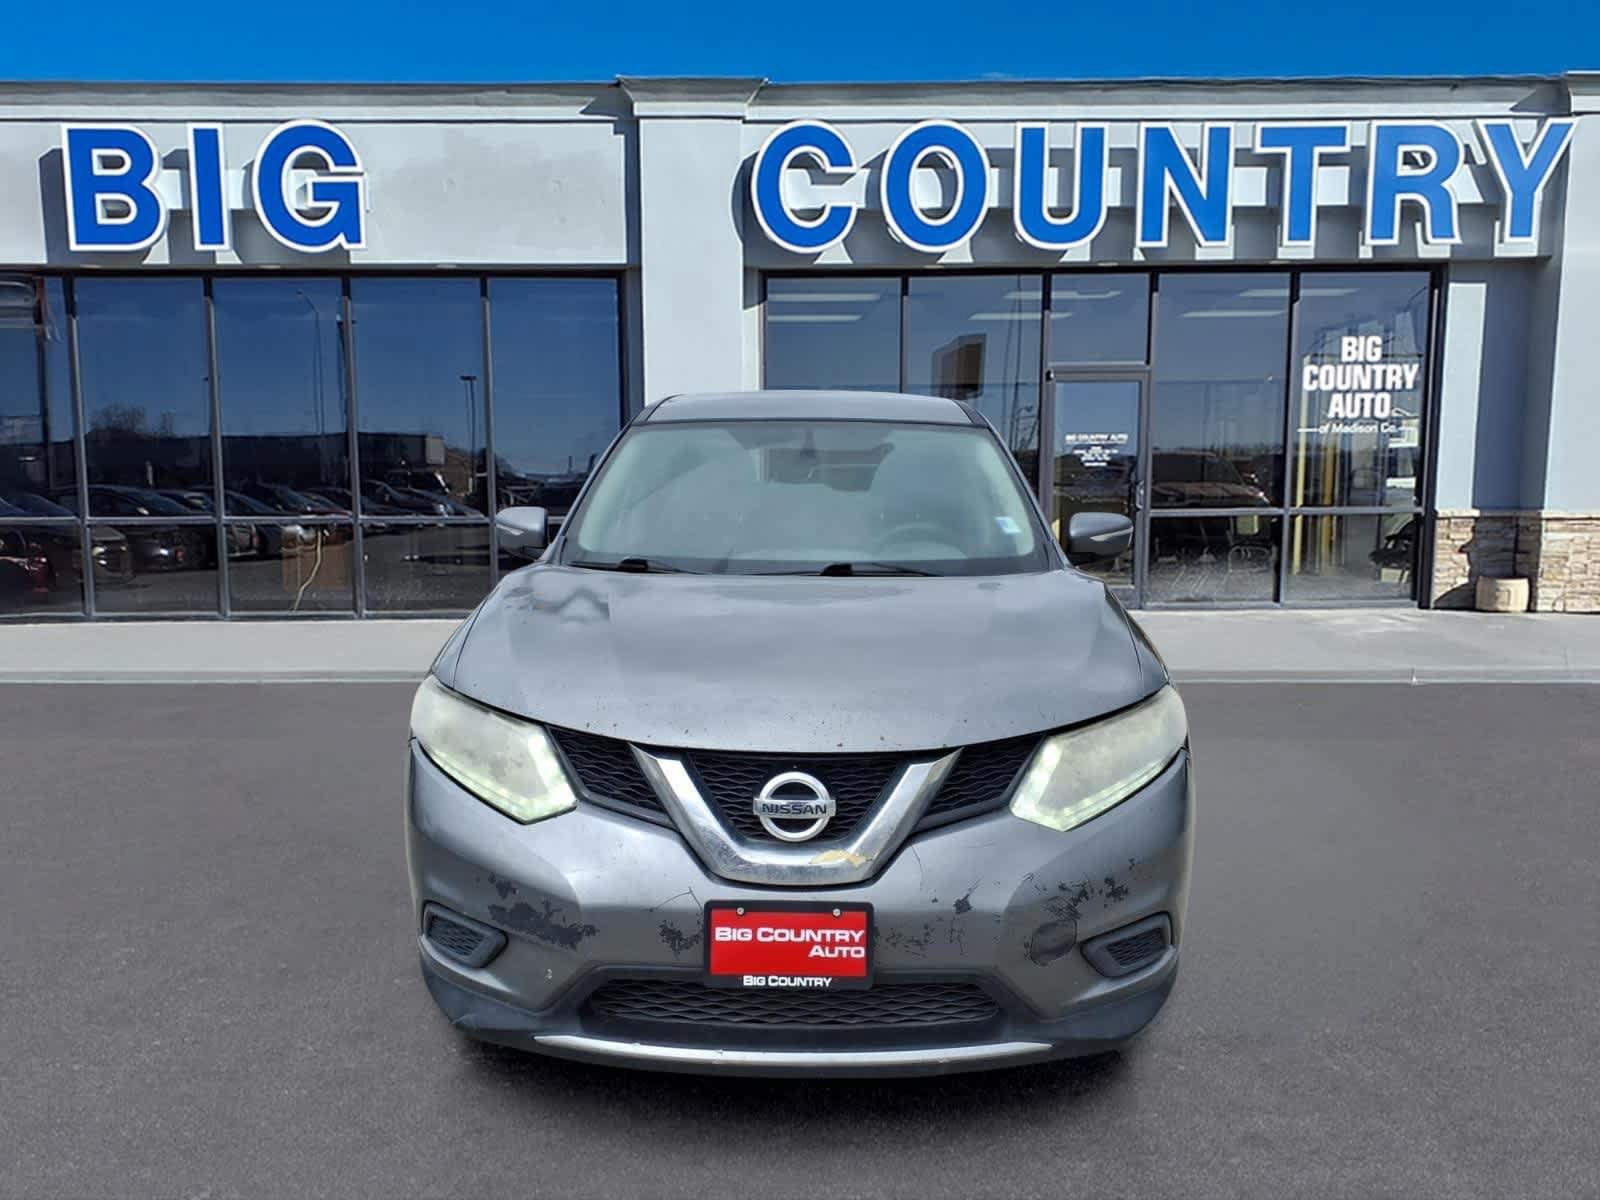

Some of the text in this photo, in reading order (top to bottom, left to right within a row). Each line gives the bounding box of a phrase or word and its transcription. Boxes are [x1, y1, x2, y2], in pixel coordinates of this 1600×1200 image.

[61, 118, 1575, 255] BIG COUNTRY
[1341, 335, 1382, 362] BIG
[1303, 363, 1420, 391] COUNTRY
[1327, 392, 1392, 419] AUTO
[1319, 421, 1331, 434] of
[1331, 421, 1379, 433] Madison
[761, 802, 828, 815] NISSAN
[714, 926, 865, 943] BIG COUNTRY
[808, 945, 866, 959] AUTO
[767, 976, 833, 988] COUNTRY
